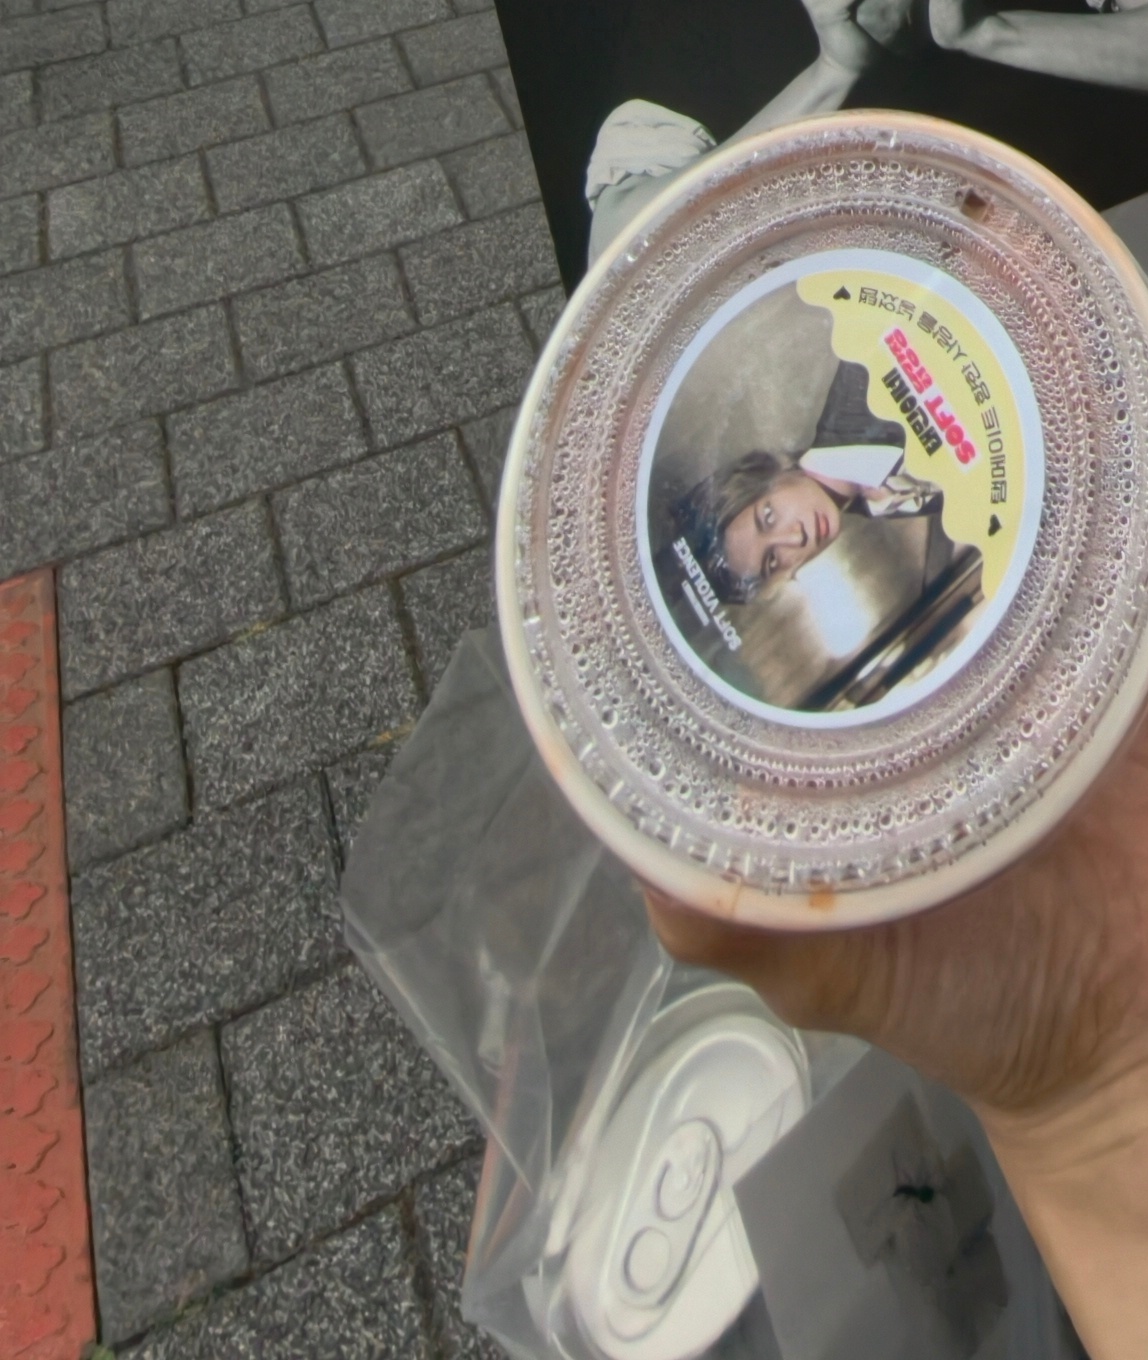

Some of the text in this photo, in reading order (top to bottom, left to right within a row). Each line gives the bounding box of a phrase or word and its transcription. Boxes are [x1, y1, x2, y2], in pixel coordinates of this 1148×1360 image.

[917, 310, 968, 362] 사랑을
[881, 366, 943, 458] 태민이네
[923, 394, 976, 465] SOFT
[672, 536, 719, 614] VIOLENCE
[713, 610, 742, 651] SOFT
